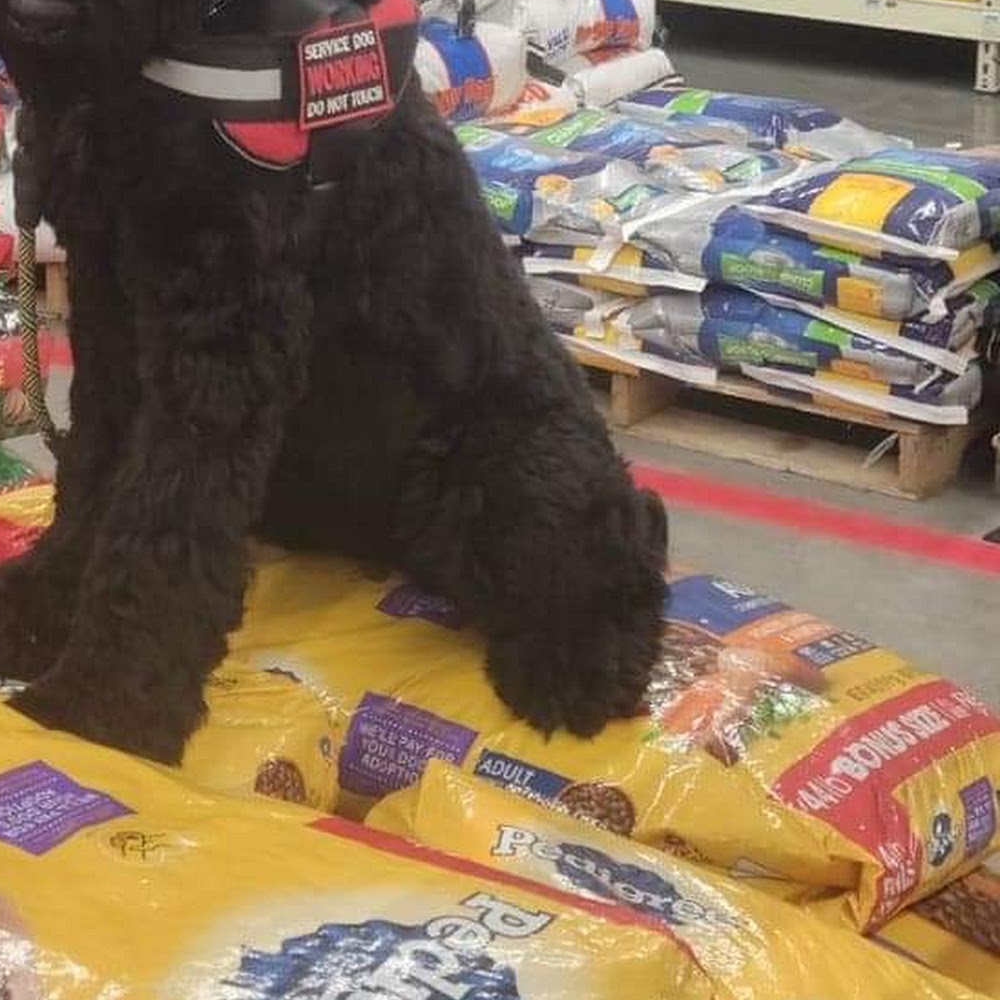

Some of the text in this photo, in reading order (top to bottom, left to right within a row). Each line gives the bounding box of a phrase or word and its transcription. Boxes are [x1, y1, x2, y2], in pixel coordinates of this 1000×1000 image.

[305, 30, 376, 60] SERVICE DOG
[306, 52, 382, 95] WORKING
[307, 85, 384, 118] DO NOT TOUCH
[361, 753, 421, 783] ADOPTIO
[481, 757, 535, 788] ADULT
